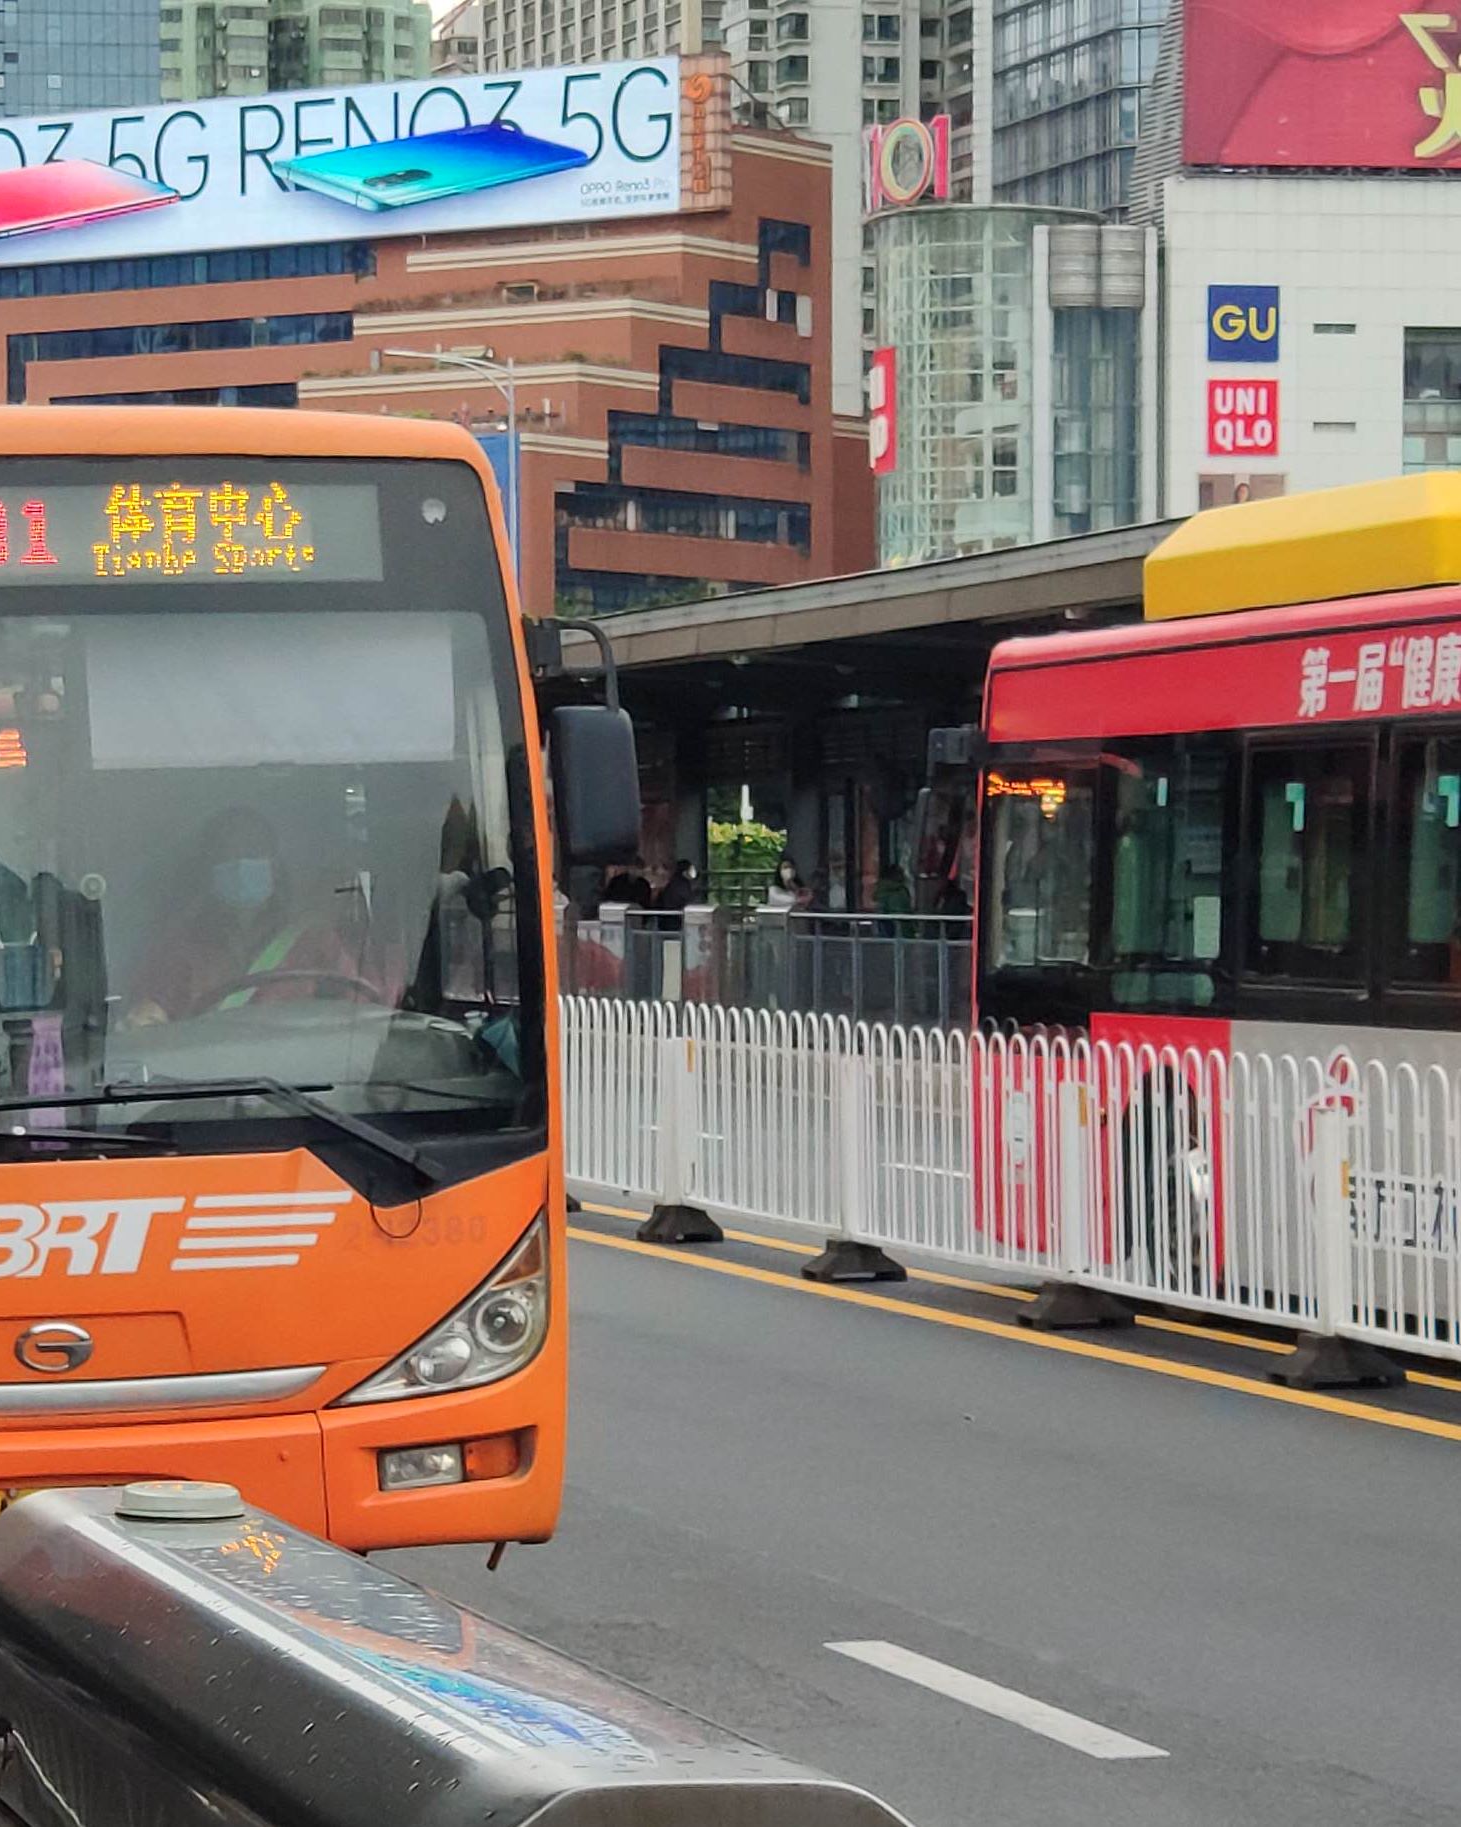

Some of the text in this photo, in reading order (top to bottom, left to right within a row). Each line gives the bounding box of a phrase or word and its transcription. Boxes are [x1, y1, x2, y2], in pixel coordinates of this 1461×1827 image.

[108, 111, 210, 201] 5G
[561, 66, 673, 162] 5G
[1212, 304, 1277, 341] GU
[1214, 387, 1268, 416] UNI
[1214, 419, 1273, 451] QLO
